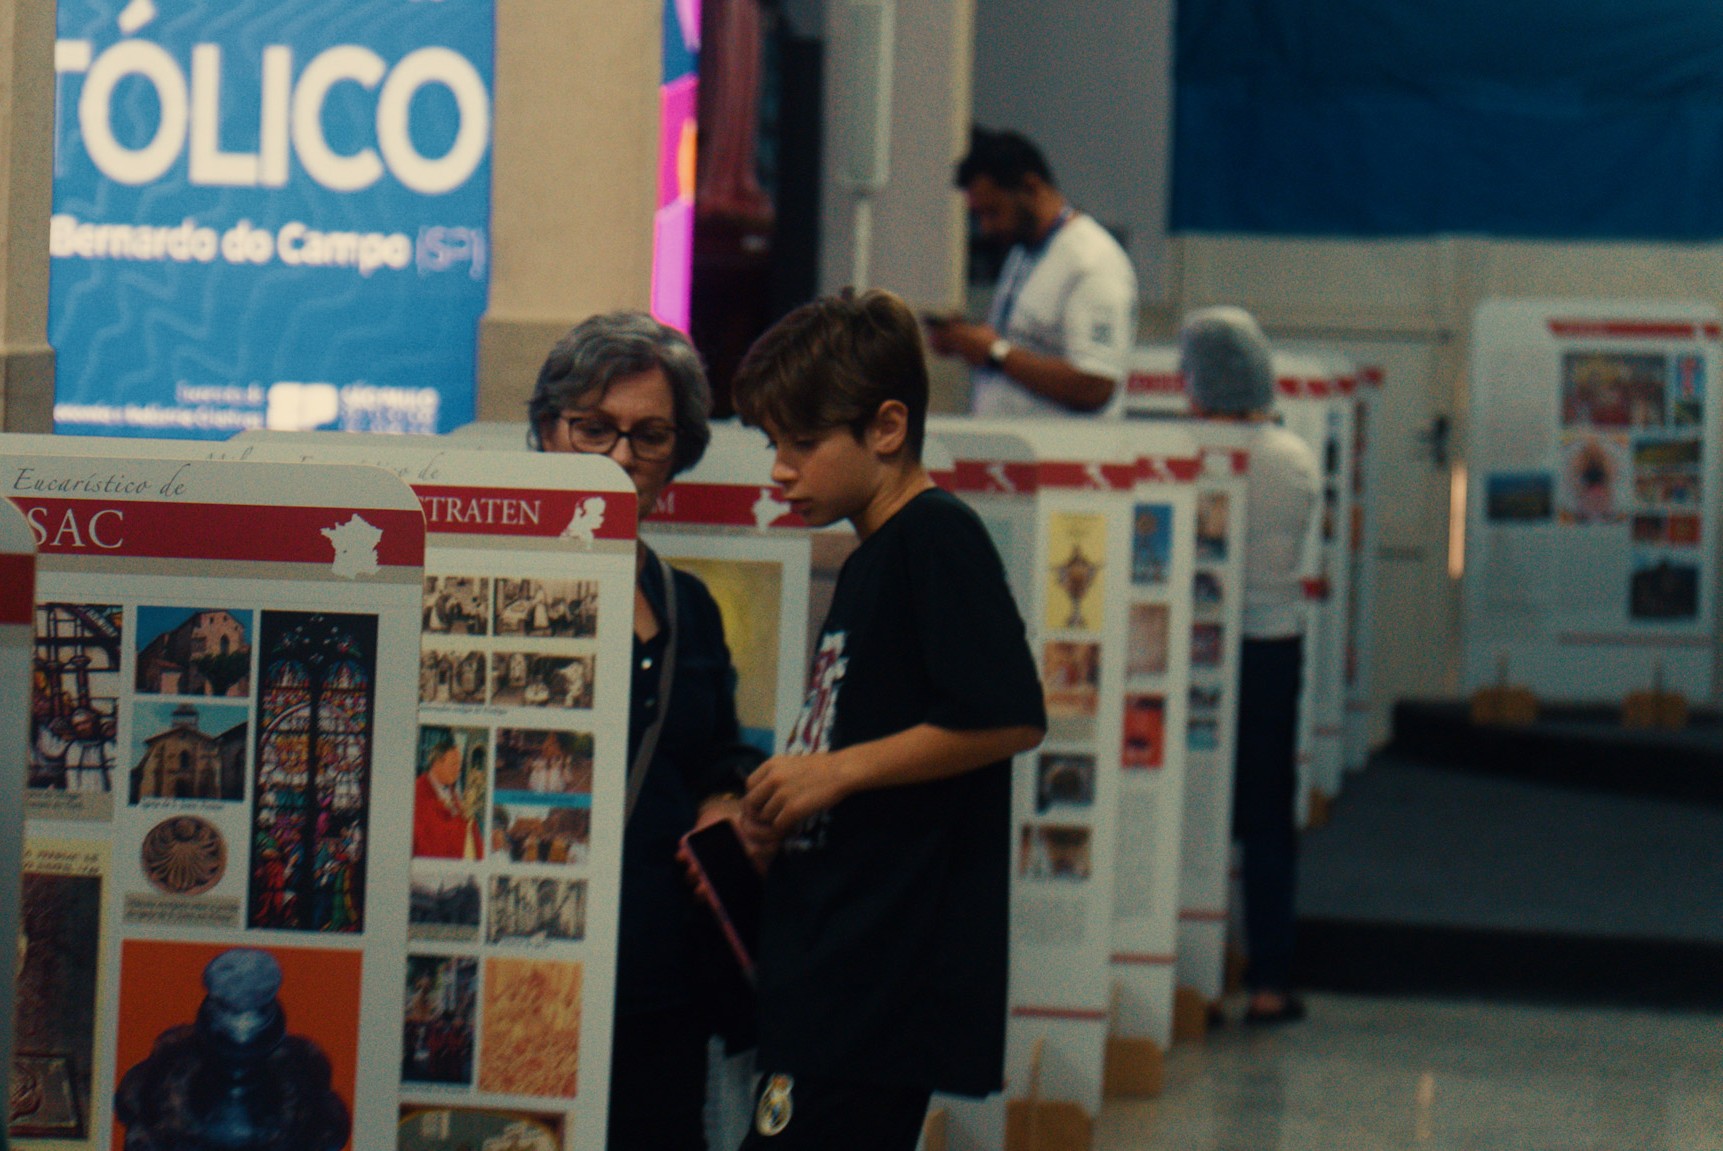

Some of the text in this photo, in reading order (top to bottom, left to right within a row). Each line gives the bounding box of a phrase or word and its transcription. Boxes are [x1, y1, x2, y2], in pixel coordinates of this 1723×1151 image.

[50, 214, 218, 262] Bernardo
[221, 218, 273, 264] do
[276, 221, 412, 278] Campo
[13, 463, 191, 497] Eucarístico de
[26, 506, 125, 549] SAC
[416, 495, 542, 525] TRATEN
